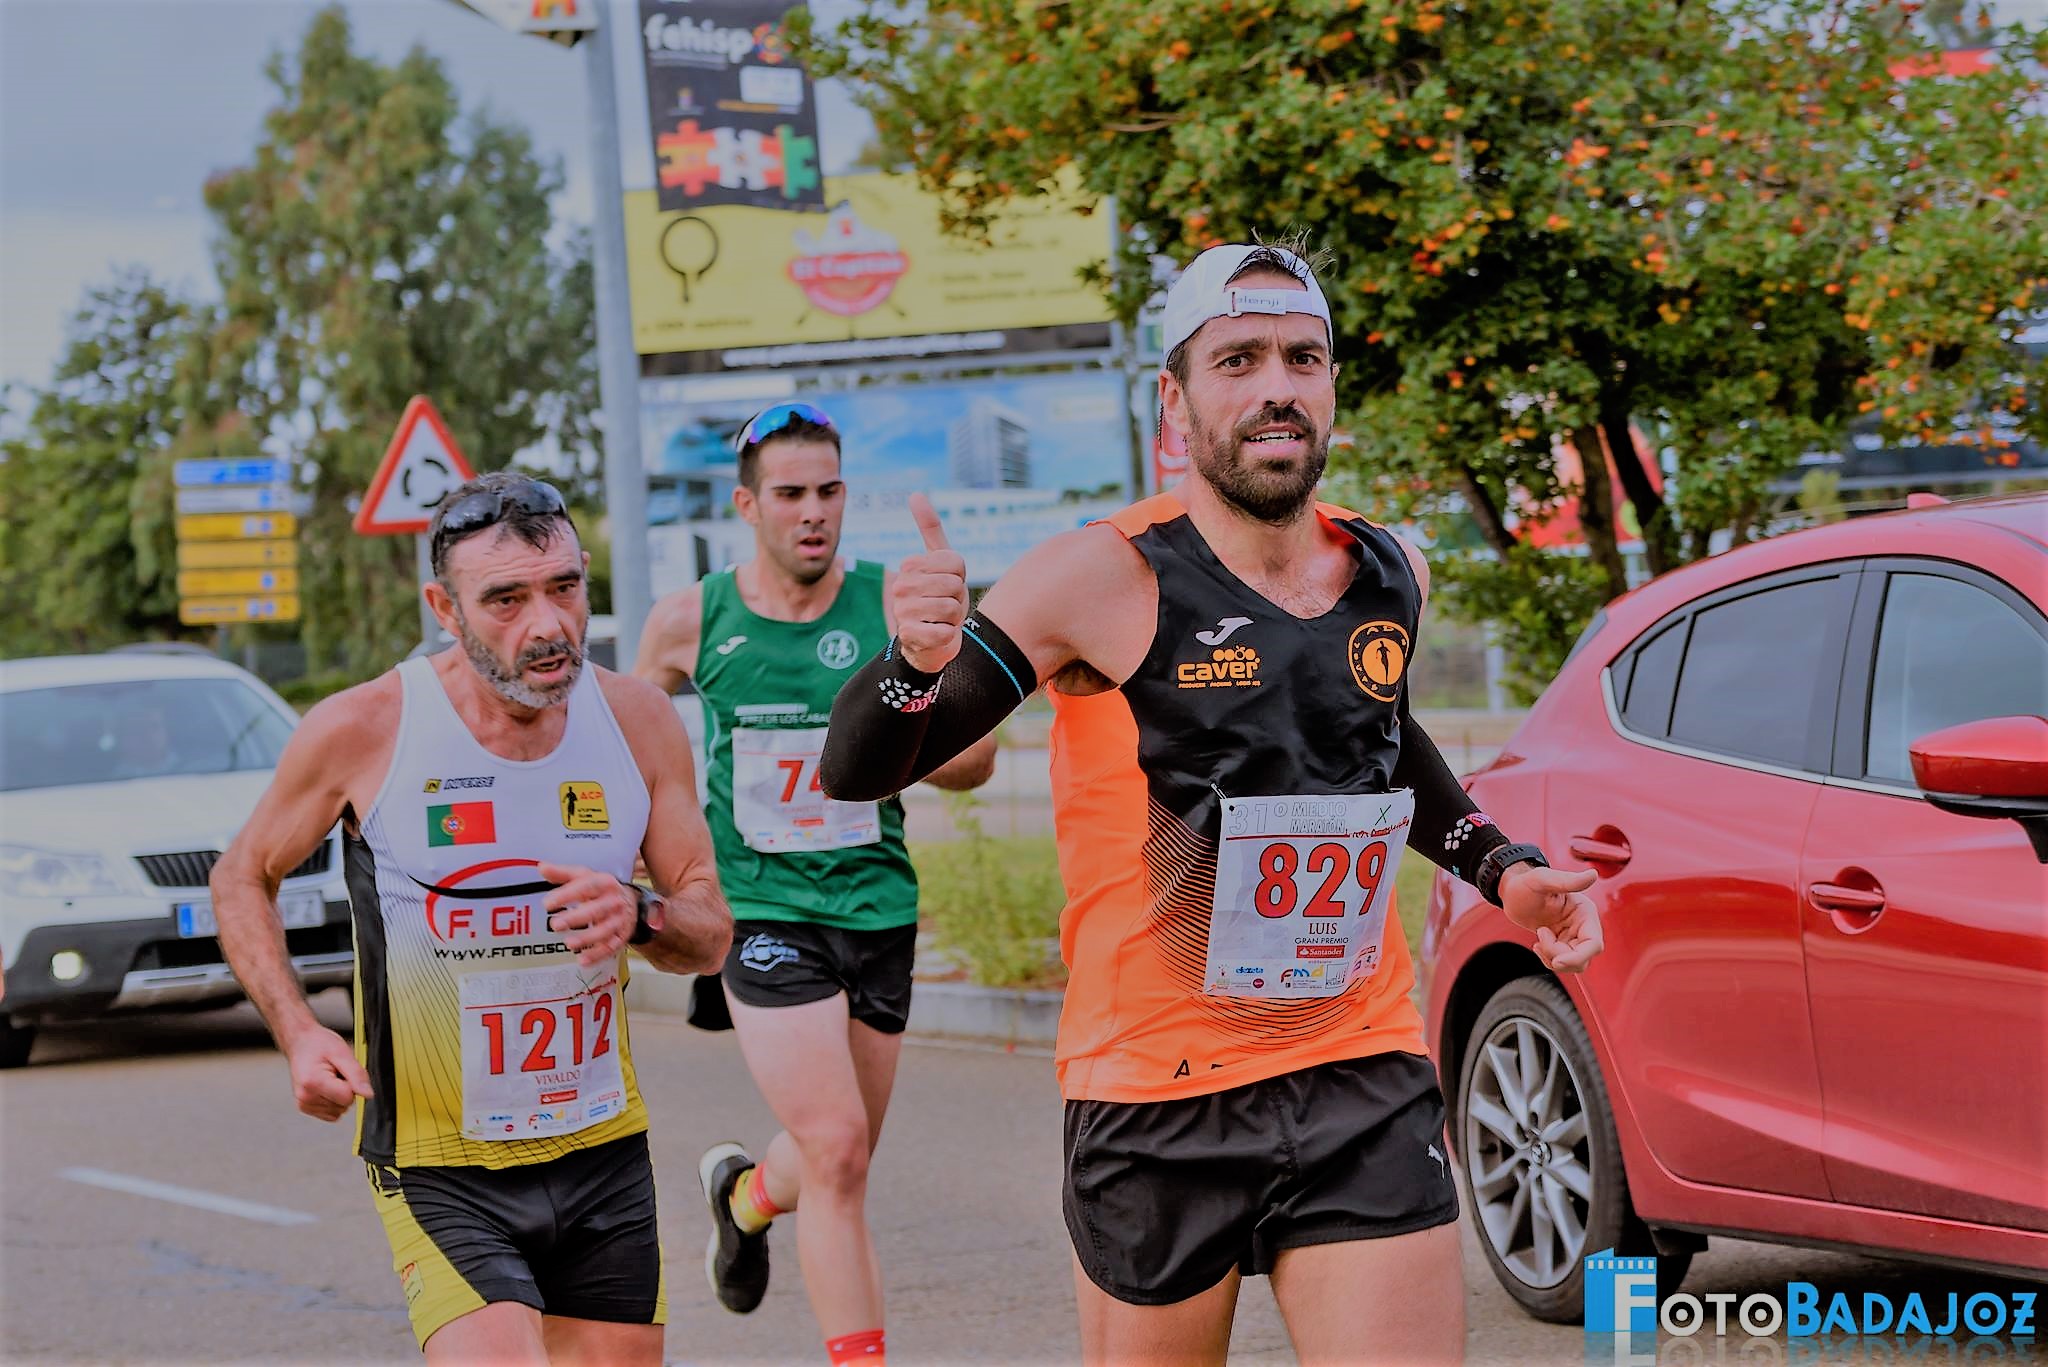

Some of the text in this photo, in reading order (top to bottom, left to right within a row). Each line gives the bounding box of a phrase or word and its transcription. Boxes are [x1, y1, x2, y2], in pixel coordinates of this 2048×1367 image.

[1177, 661, 1258, 682] caver
[1292, 802, 1347, 817] MEDIO
[1290, 816, 1346, 834] MARATÓN
[1254, 841, 1388, 919] 829
[491, 905, 530, 936] Gil
[1309, 922, 1338, 935] LUIS
[1294, 937, 1318, 945] GRAN
[1309, 948, 1343, 957] Santander
[482, 993, 612, 1075] 1212
[535, 1070, 581, 1085] VIVALDO
